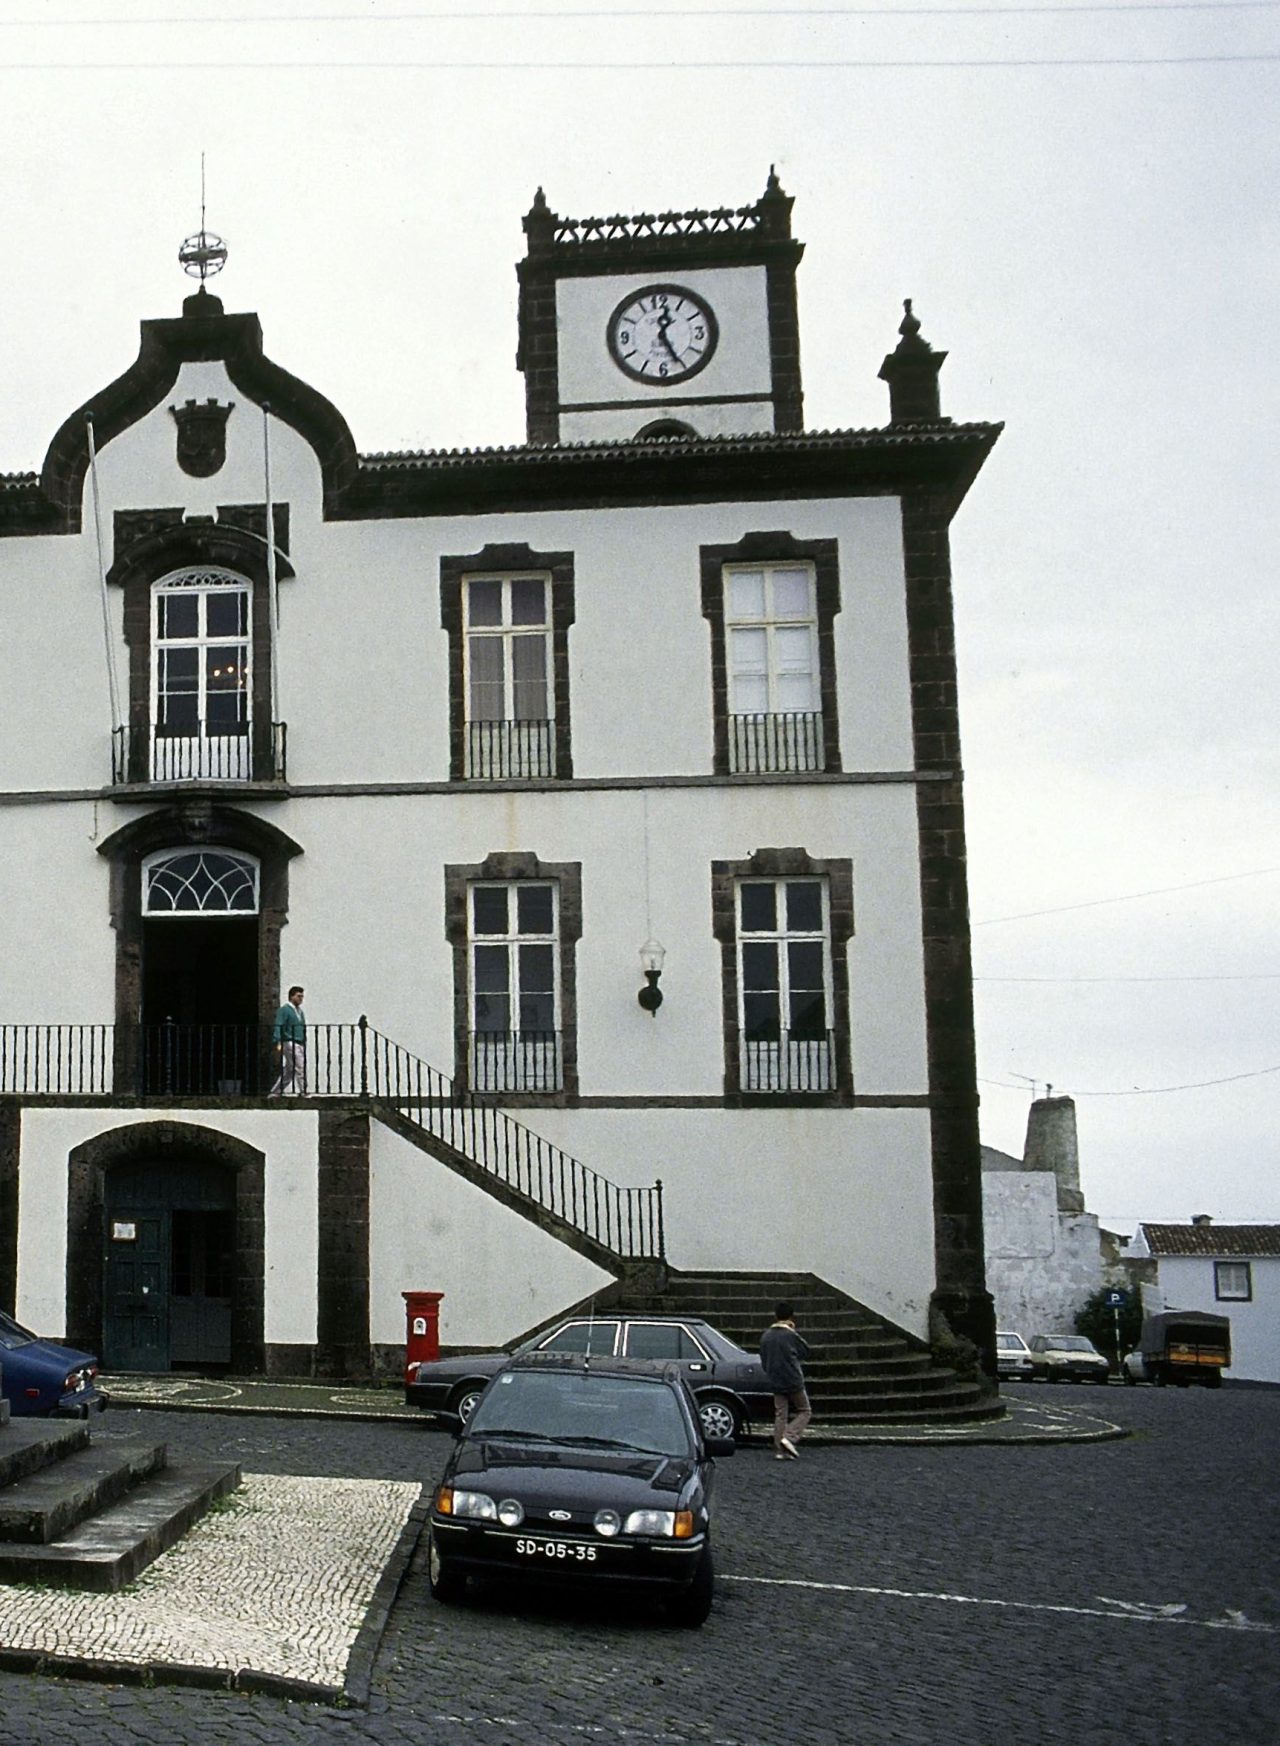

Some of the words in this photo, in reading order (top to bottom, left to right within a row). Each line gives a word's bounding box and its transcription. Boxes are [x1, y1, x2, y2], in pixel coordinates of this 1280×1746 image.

[650, 295, 668, 310] 12
[620, 331, 630, 345] 9
[694, 326, 705, 340] 3
[659, 362, 669, 377] 6
[1111, 1293, 1121, 1303] P
[516, 1540, 597, 1561] SD-05-35
